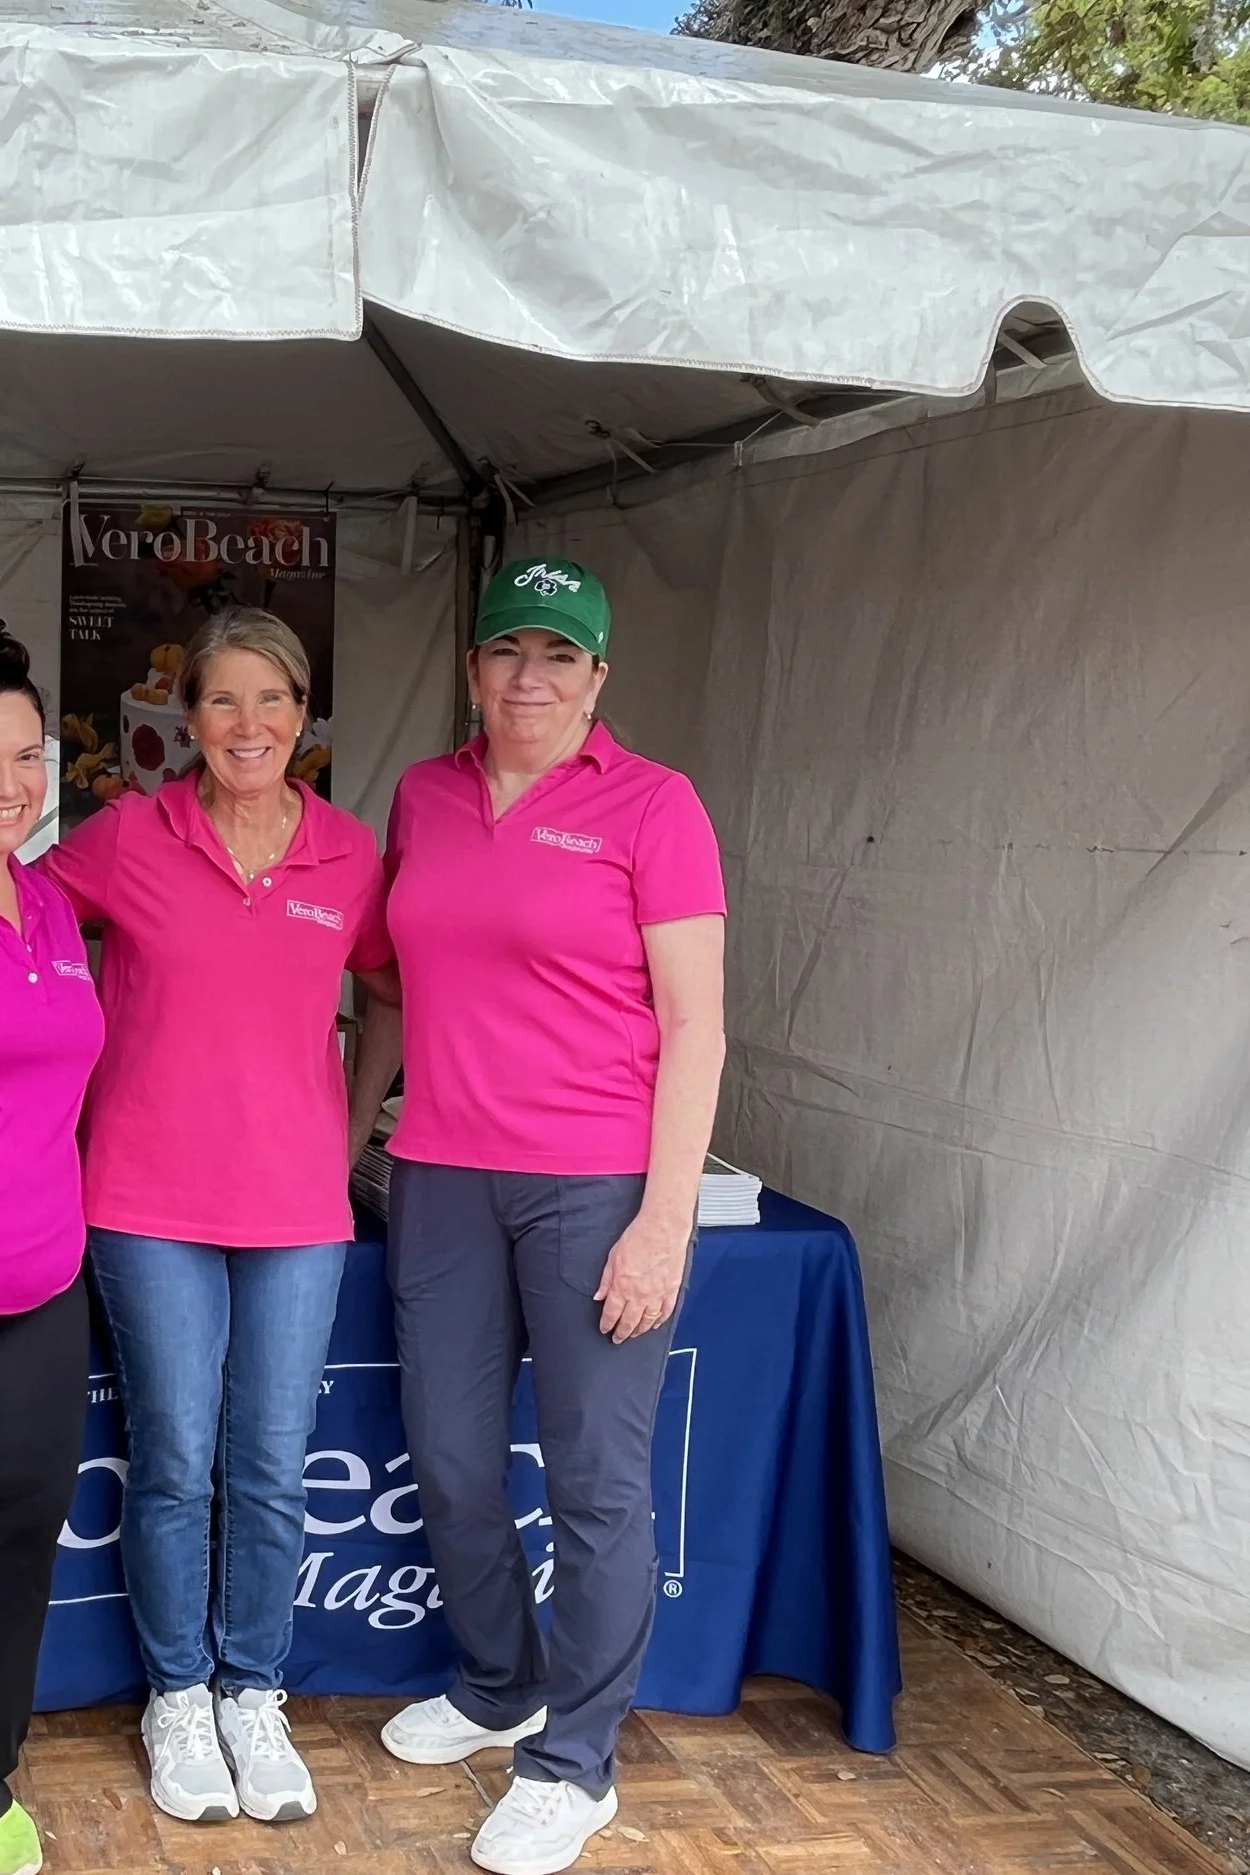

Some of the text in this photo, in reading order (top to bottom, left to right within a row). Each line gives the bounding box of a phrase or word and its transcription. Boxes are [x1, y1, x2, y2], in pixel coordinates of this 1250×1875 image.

[79, 514, 330, 568] VeroBeach
[69, 615, 114, 628] SWEET
[69, 628, 101, 641] TALK
